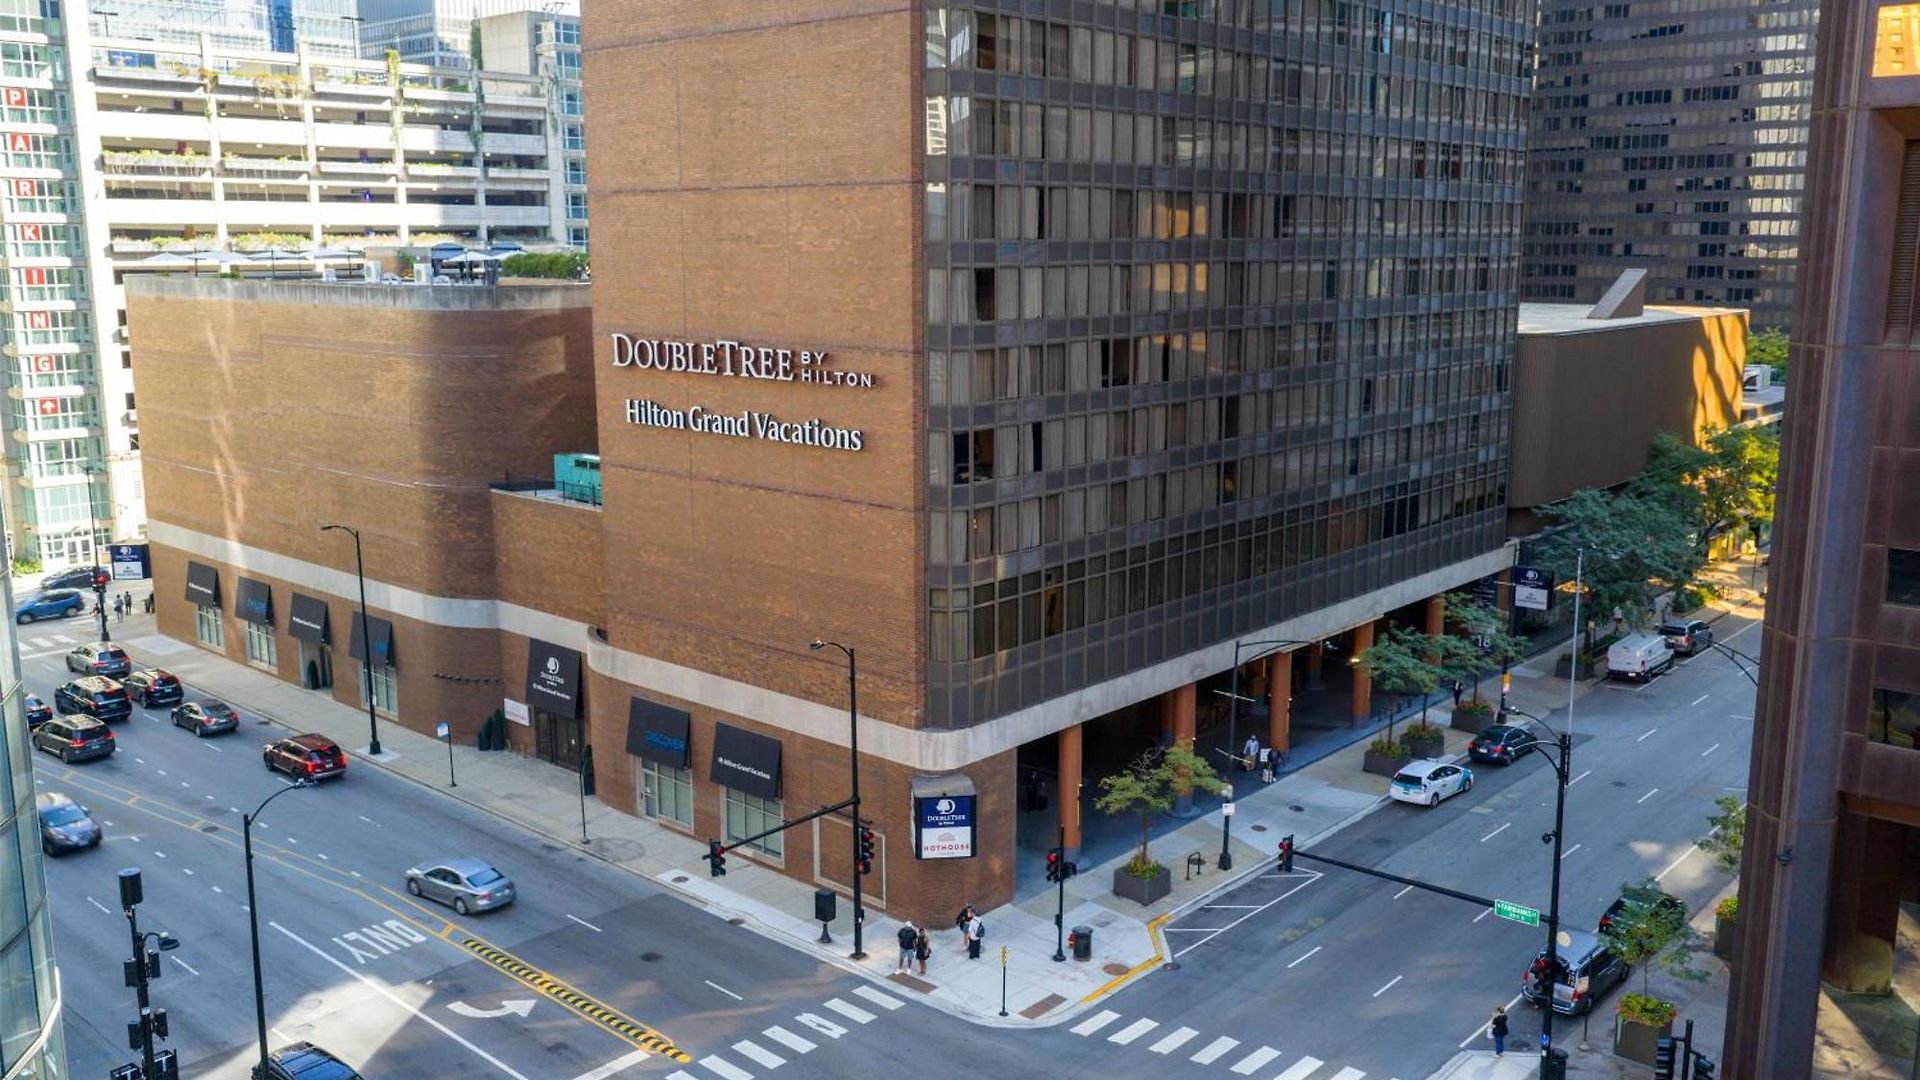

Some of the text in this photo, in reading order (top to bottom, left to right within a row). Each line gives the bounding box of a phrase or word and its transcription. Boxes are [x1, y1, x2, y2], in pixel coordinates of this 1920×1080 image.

[10, 90, 52, 372] PARKING
[611, 333, 826, 381] DOUBLETREE BY
[801, 370, 873, 388] HILTON
[625, 399, 863, 451] Hilton Grand Vacations
[332, 920, 427, 965] ONLY
